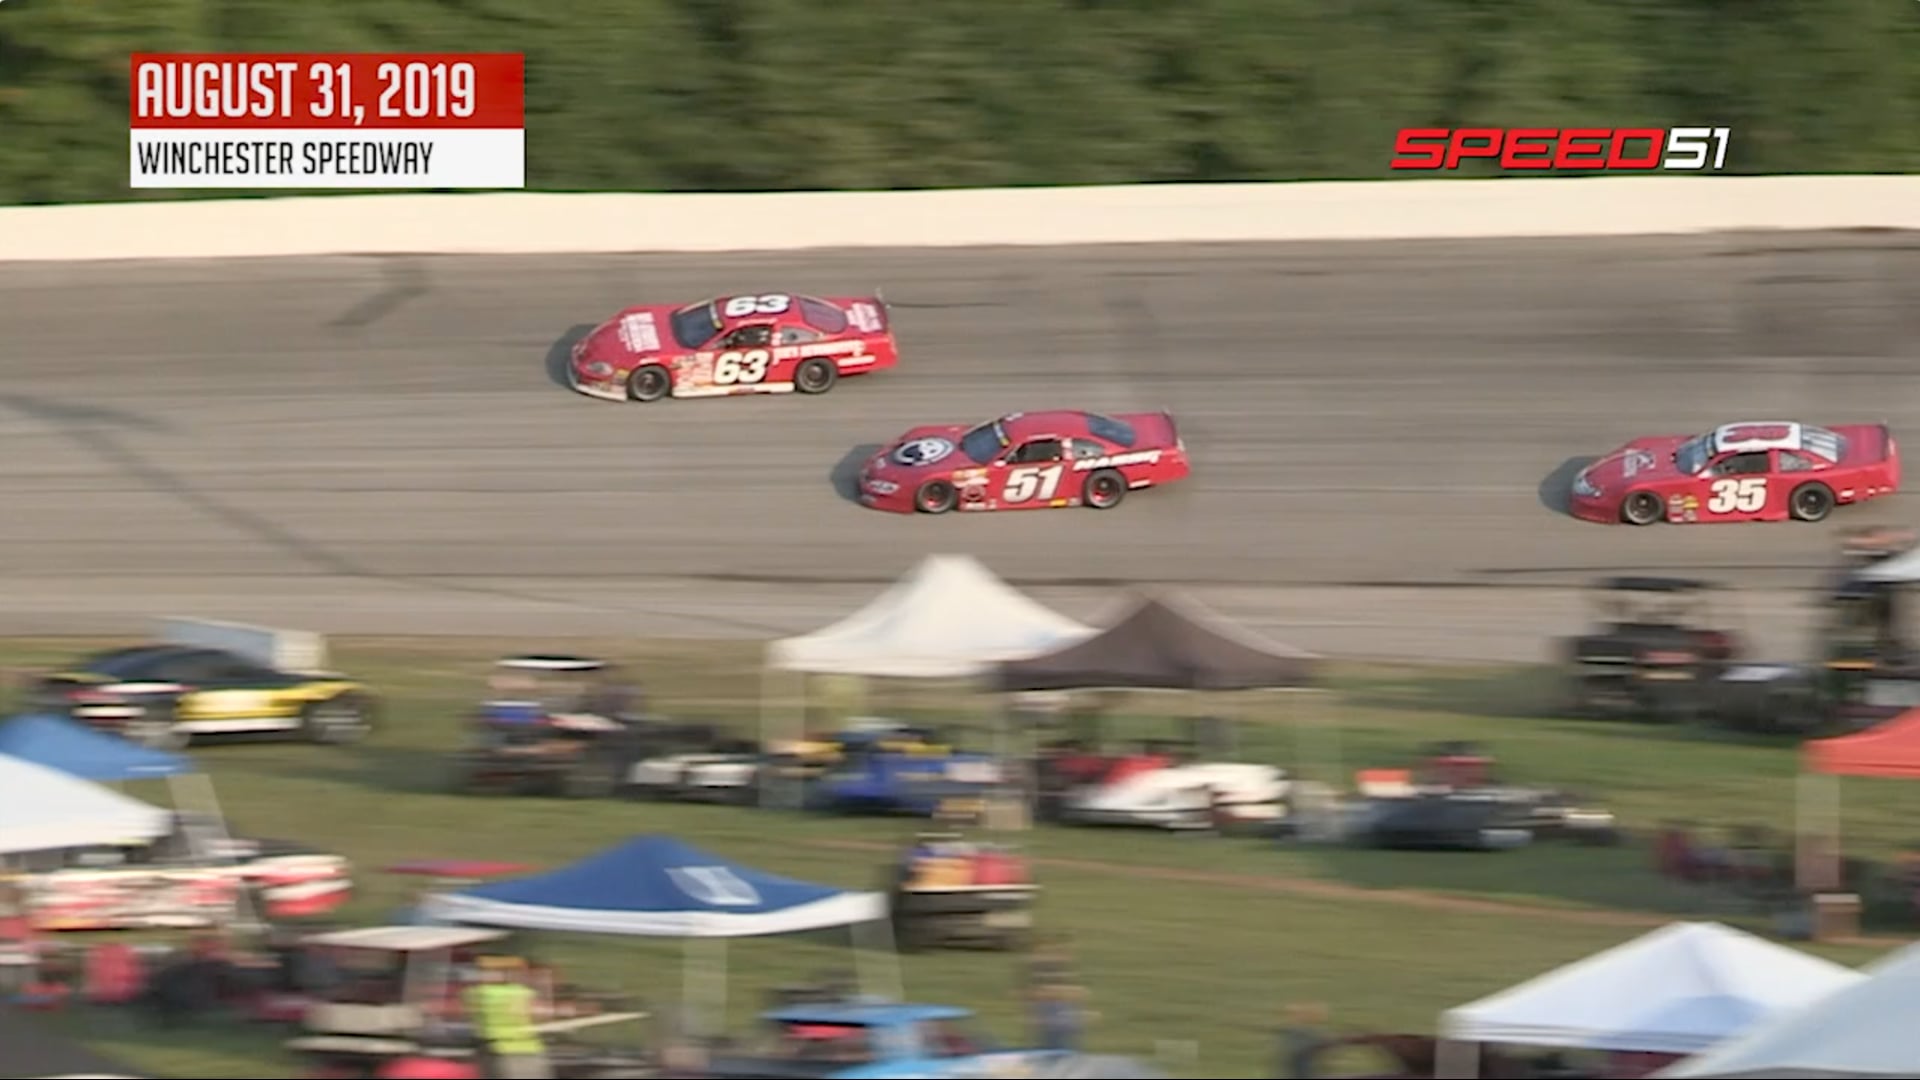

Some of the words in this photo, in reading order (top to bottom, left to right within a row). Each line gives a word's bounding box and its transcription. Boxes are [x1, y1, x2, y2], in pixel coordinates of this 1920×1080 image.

[724, 293, 792, 317] 63
[713, 348, 770, 385] 63
[1002, 464, 1064, 503] 51
[1707, 478, 1767, 513] 35
